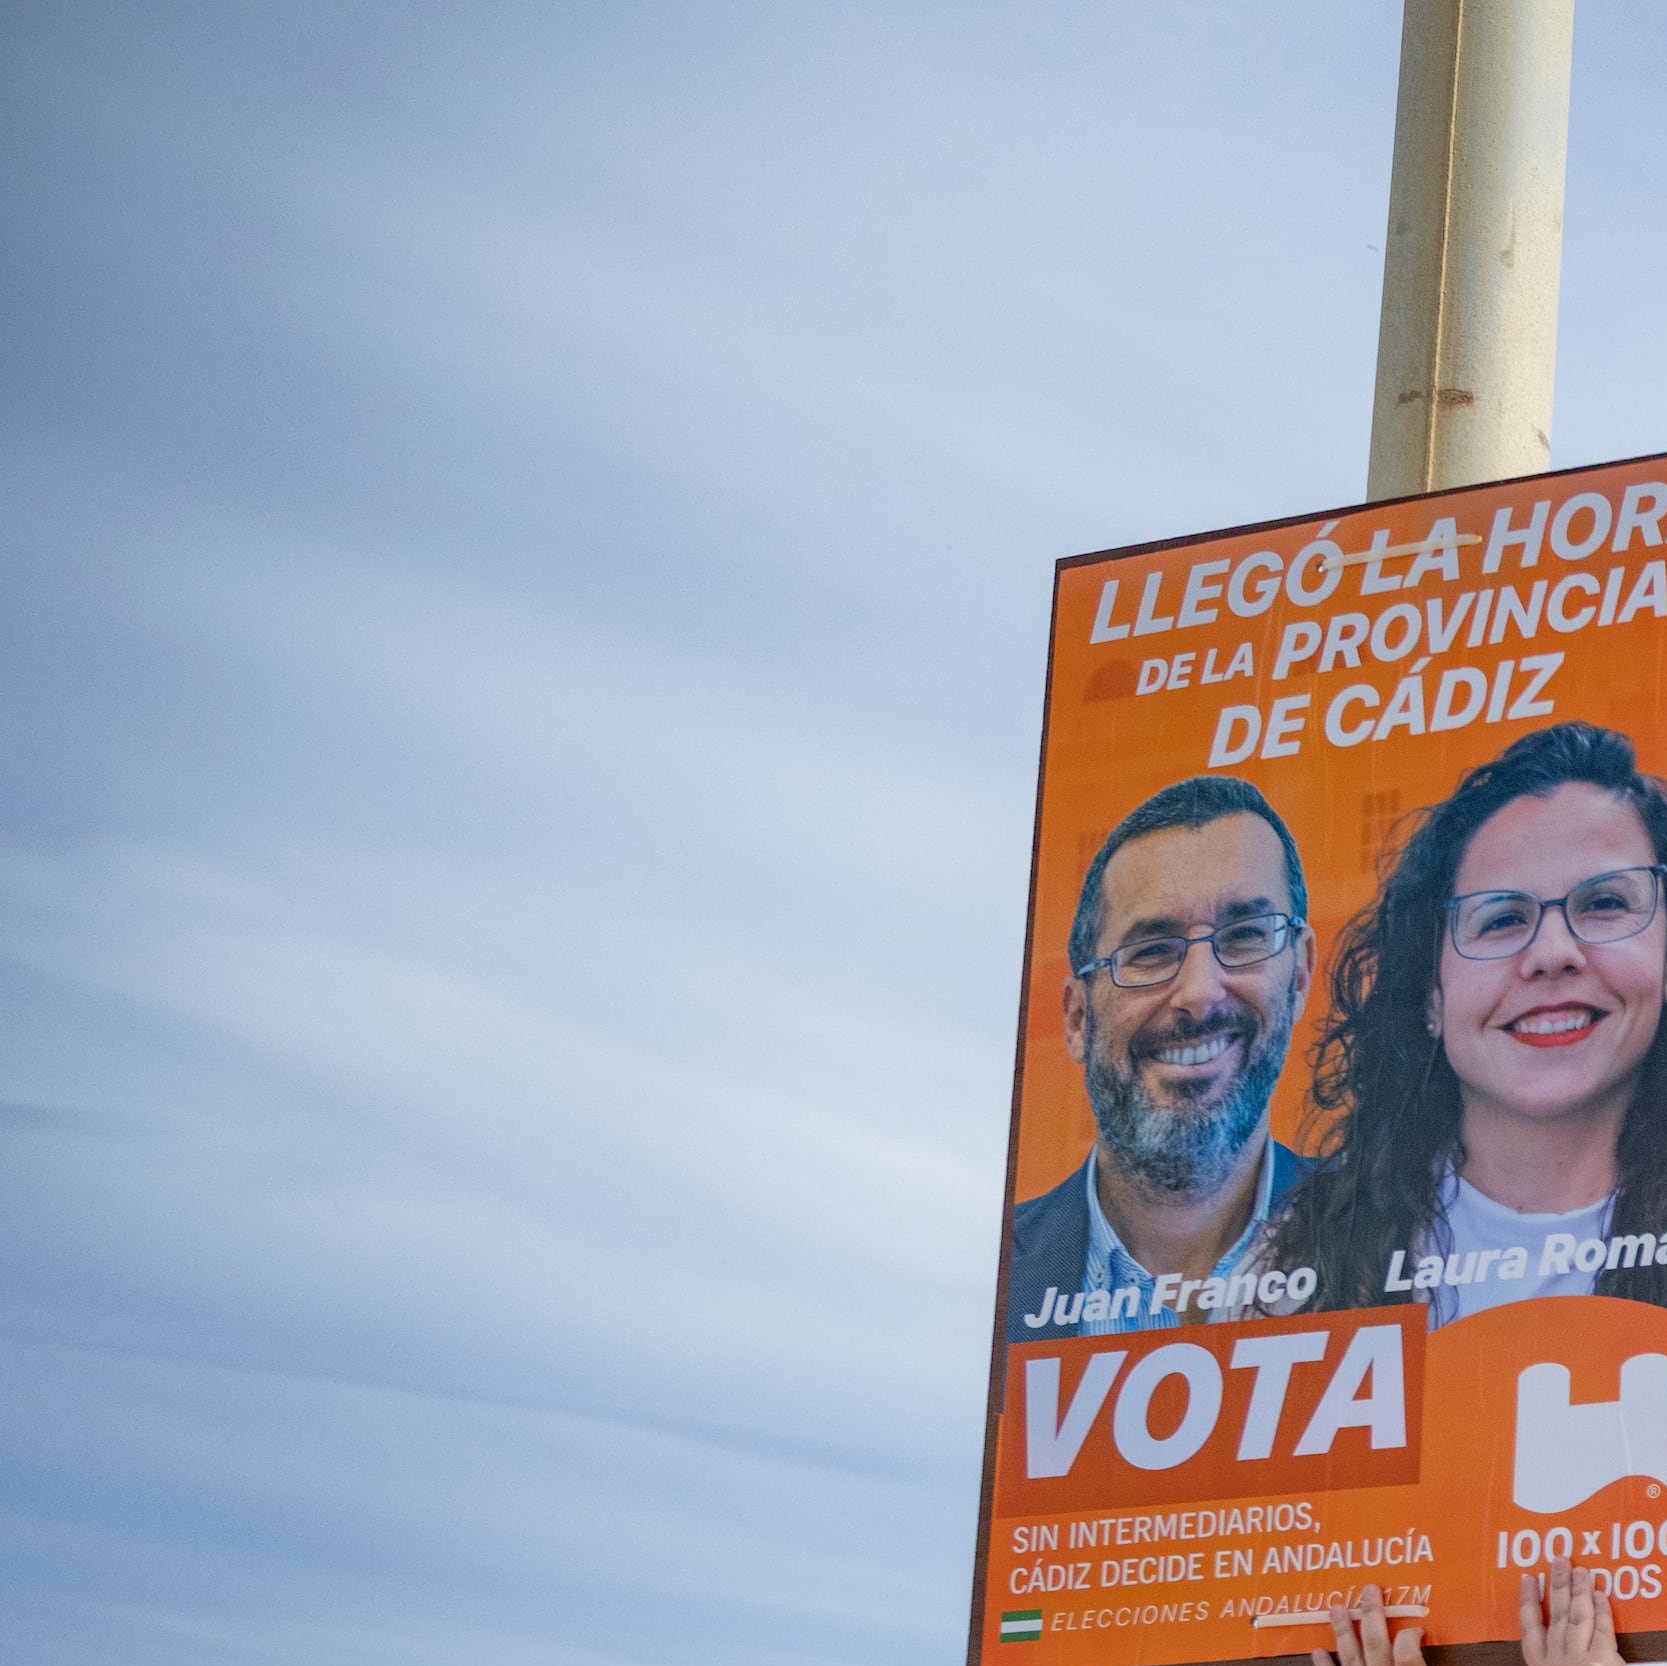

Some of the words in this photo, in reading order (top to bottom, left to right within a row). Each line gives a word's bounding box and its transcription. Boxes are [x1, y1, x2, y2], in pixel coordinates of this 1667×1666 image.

[1090, 521, 1344, 645] LLEGÓ
[1360, 517, 1460, 596] LA
[1135, 652, 1197, 696] DE
[1200, 642, 1254, 685] LA
[1208, 694, 1312, 769] DE
[1325, 652, 1566, 748] CÁDIZ
[1023, 1286, 1141, 1328] Juan
[1149, 1266, 1318, 1315] Franco
[1384, 1246, 1528, 1293] Laura
[1025, 1324, 1407, 1480] VOTA
[1012, 1523, 1059, 1554] SIN
[1069, 1501, 1321, 1549] INTERMEDIARIOS,
[1009, 1558, 1092, 1595] CÁDIZ
[1100, 1552, 1205, 1588] DECIDE
[1214, 1549, 1254, 1579] EN
[1261, 1528, 1434, 1575] ANDALUCÍA
[1522, 1563, 1663, 1602] DOS
[1051, 1600, 1211, 1632] ELECCIONES
[1385, 1584, 1433, 1606] 17M
